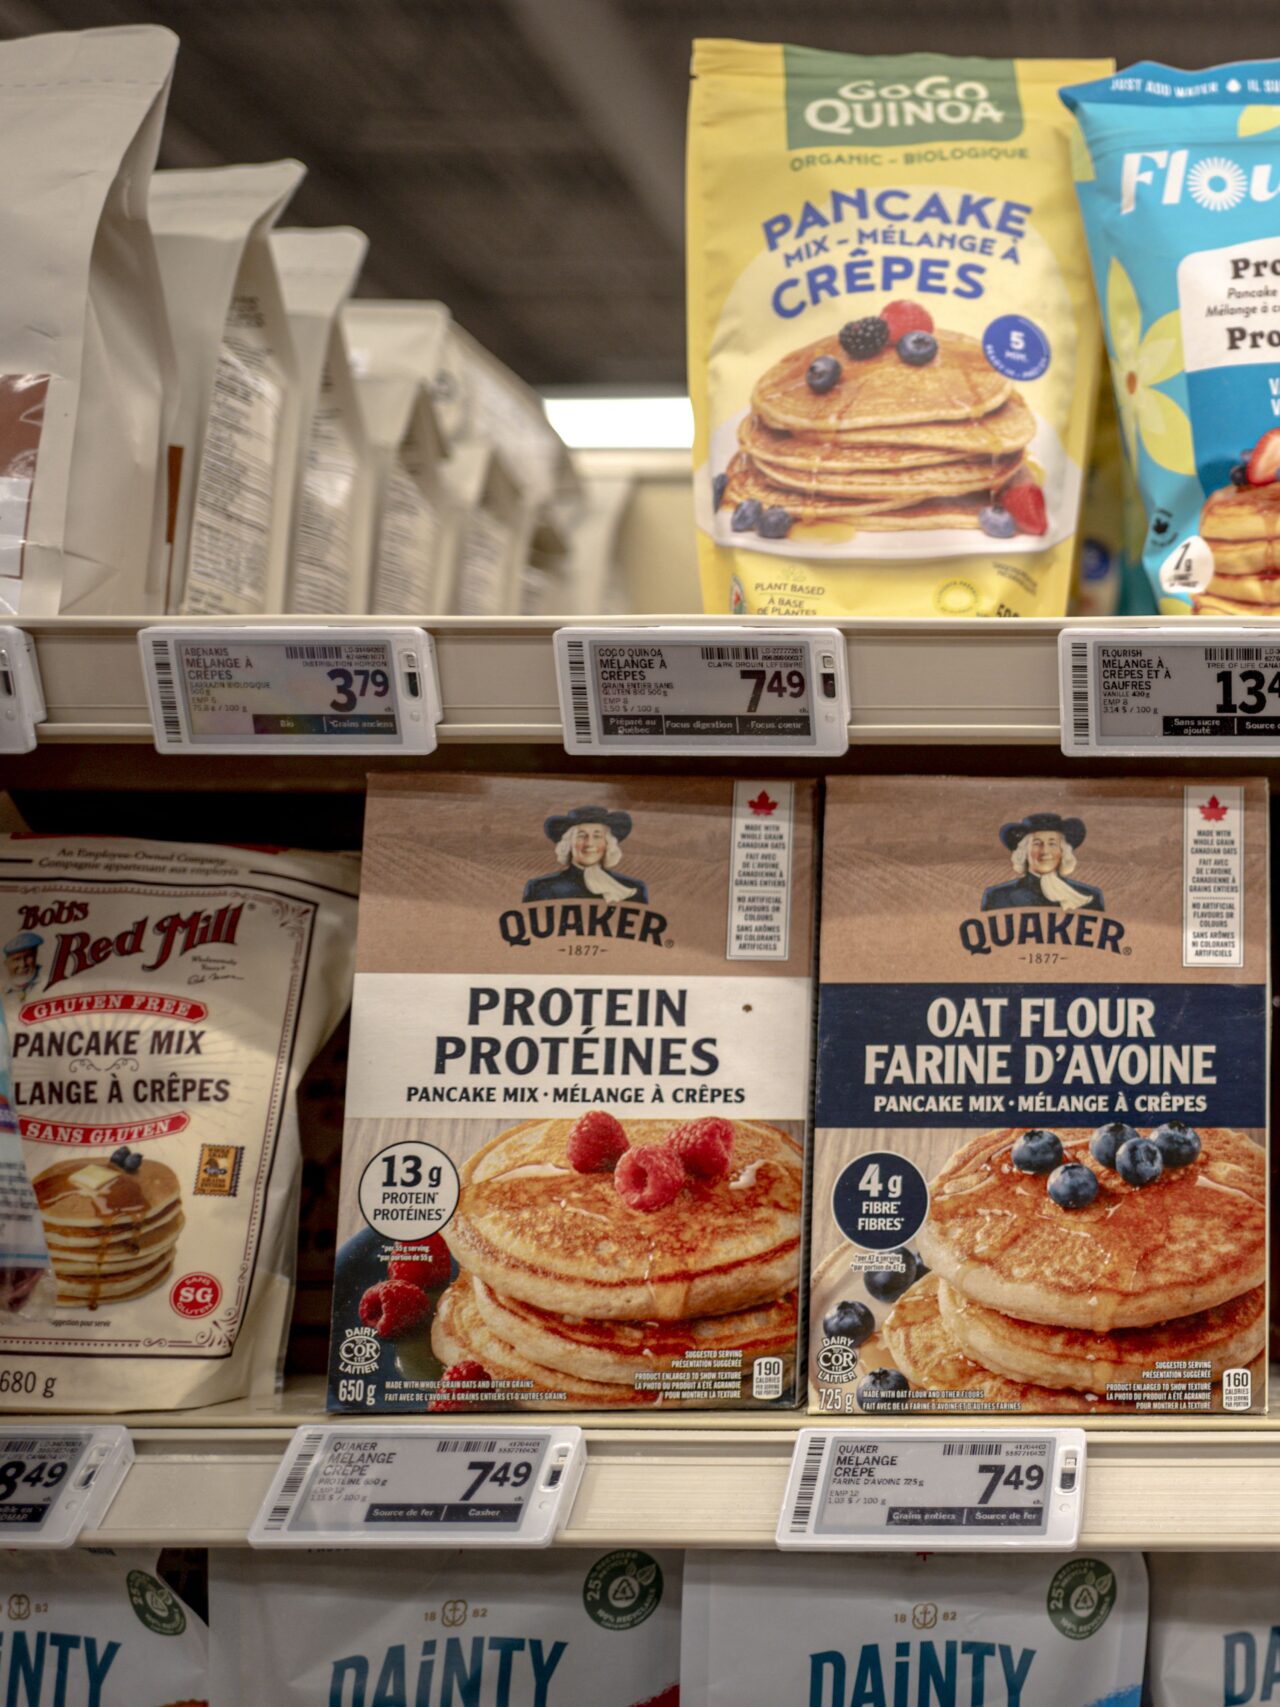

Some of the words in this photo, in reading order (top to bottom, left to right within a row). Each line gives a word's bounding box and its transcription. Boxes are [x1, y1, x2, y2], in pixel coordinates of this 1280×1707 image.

[1110, 79, 1142, 92] JUST
[1145, 80, 1170, 96] ADD
[1174, 81, 1219, 98] WATER
[804, 99, 1004, 134] QUINOA
[789, 149, 882, 172] ORGANIC
[903, 148, 1029, 166] BIOLOGIQUE
[762, 188, 1032, 251] PANCAKE
[783, 235, 830, 268] MIX
[858, 225, 996, 256] MÉLANGE
[1001, 237, 1019, 264] À
[771, 248, 987, 319] CRÊPES
[1227, 284, 1278, 299] Pancake
[755, 583, 787, 592] PLANT
[789, 584, 824, 596] BASED
[1103, 681, 1152, 690] GAUFRES
[693, 721, 732, 730] digestion
[17, 901, 89, 930] Bob's
[499, 903, 668, 948] QUAKER
[959, 912, 1125, 956] QUAKER
[43, 917, 148, 992] Red
[141, 902, 245, 972] Mill
[33, 993, 123, 1019] GLUTEN
[132, 995, 192, 1017] FREE
[467, 987, 687, 1028] PROTEIN
[926, 997, 1008, 1039] OAT
[1020, 997, 1155, 1038] FLOUR
[13, 1030, 140, 1058] PANCAKE
[150, 1030, 206, 1055] MIX
[434, 1027, 720, 1076] PROTÉINES
[864, 1044, 1011, 1085] FARINE
[1025, 1044, 1217, 1085] D'AVOINE
[14, 1080, 97, 1105] LANGE
[108, 1073, 123, 1102] À
[133, 1072, 231, 1101] CRÊPES
[406, 1086, 496, 1103] PANCAKE
[502, 1087, 538, 1103] MIX
[553, 1084, 644, 1104] MÉLANGE
[651, 1084, 664, 1104] À
[673, 1084, 745, 1104] CRÊPES
[874, 1095, 963, 1112] PANCAKE
[969, 1095, 1004, 1112] MIX
[1018, 1092, 1109, 1112] MÉLANGE
[1114, 1092, 1128, 1112] À
[1135, 1092, 1207, 1112] CRÊPES
[26, 1122, 84, 1144] SANS
[89, 1120, 172, 1144] GLUTEN
[382, 1155, 422, 1187] 13
[429, 1166, 442, 1187] g
[858, 1163, 883, 1197] 4
[888, 1175, 903, 1198] g
[179, 1288, 213, 1304] SG
[345, 1327, 378, 1338] DAIRY
[823, 1336, 854, 1346] DAIRY
[339, 1362, 379, 1375] LAITIER
[756, 1361, 780, 1375] 190
[1142, 1370, 1182, 1378] PRÉSENTATION
[1155, 1361, 1186, 1369] SUGGESTED
[1188, 1361, 1211, 1369] SERVING
[0, 1371, 37, 1393] 680
[43, 1376, 56, 1398] g
[818, 1371, 857, 1384] LAITIER
[1225, 1372, 1249, 1387] 160
[339, 1379, 364, 1402] 650
[367, 1384, 376, 1406] g
[819, 1389, 842, 1410] 725
[846, 1393, 854, 1413] g
[333, 1442, 377, 1452] QUAKER
[838, 1445, 878, 1454] QUAKER
[420, 1508, 434, 1517] fer
[975, 1512, 1006, 1520] Source
[1009, 1512, 1021, 1520] de
[1024, 1512, 1036, 1520] fer
